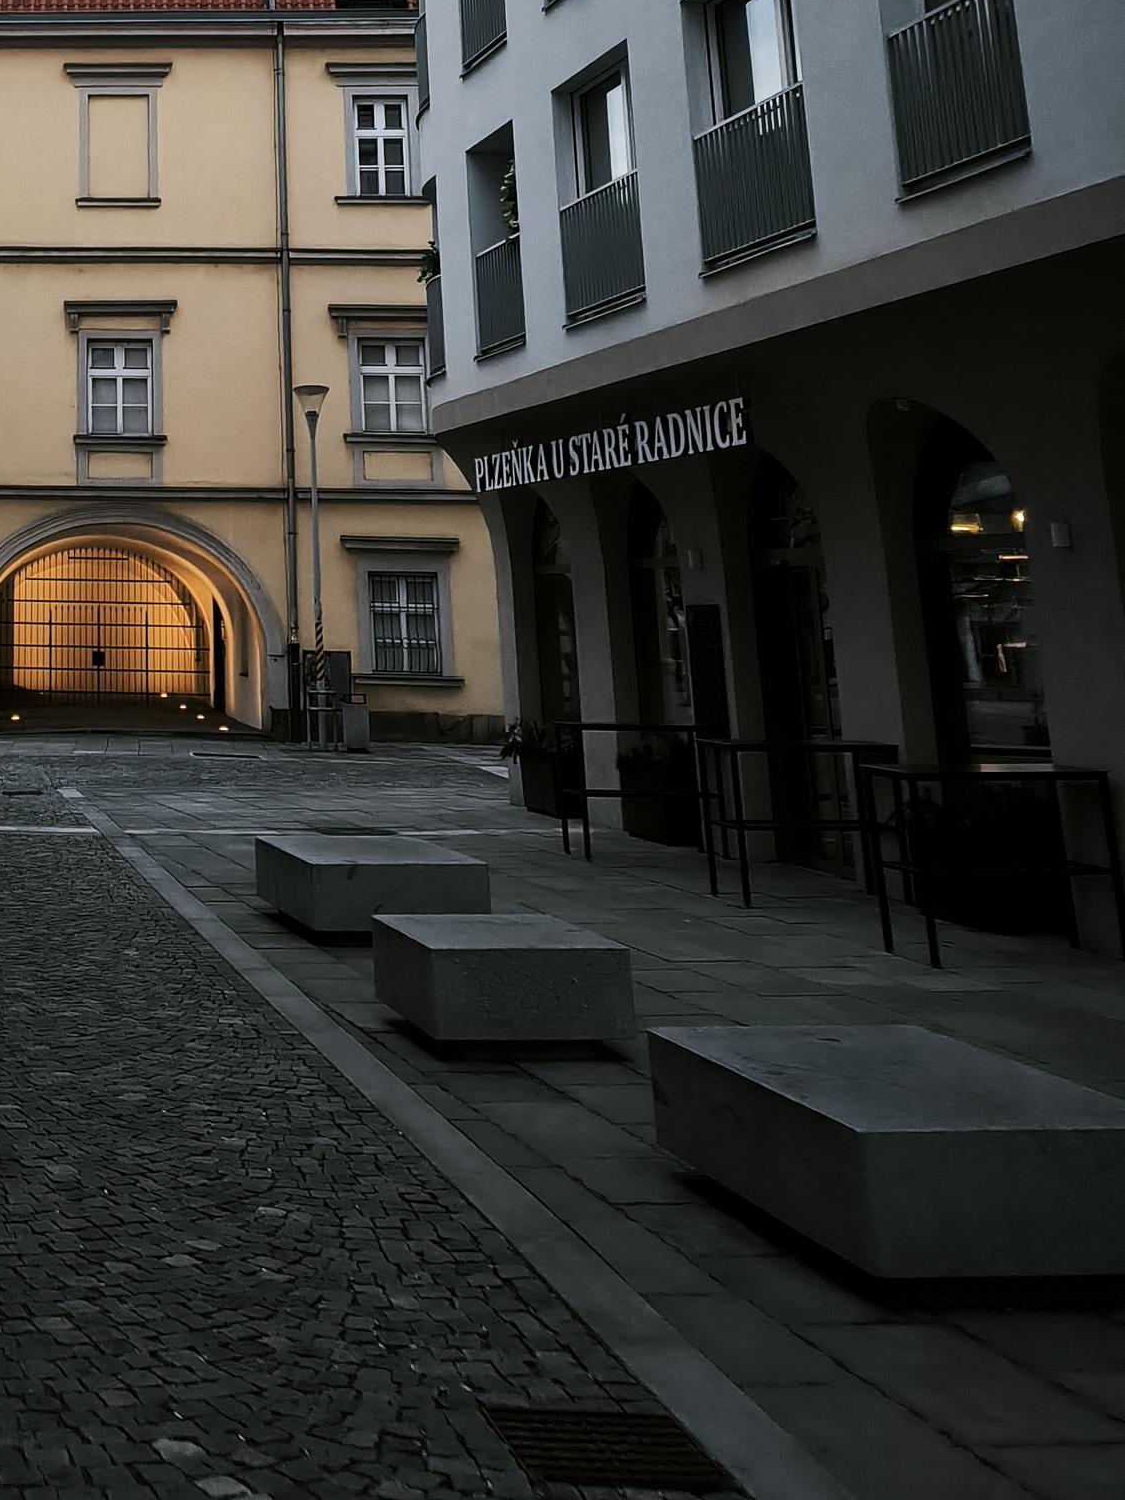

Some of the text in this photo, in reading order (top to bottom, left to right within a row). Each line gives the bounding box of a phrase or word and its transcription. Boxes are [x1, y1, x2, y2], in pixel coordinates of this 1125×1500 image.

[474, 396, 748, 493] PLZEŇKA U STARÉ RADNICE
